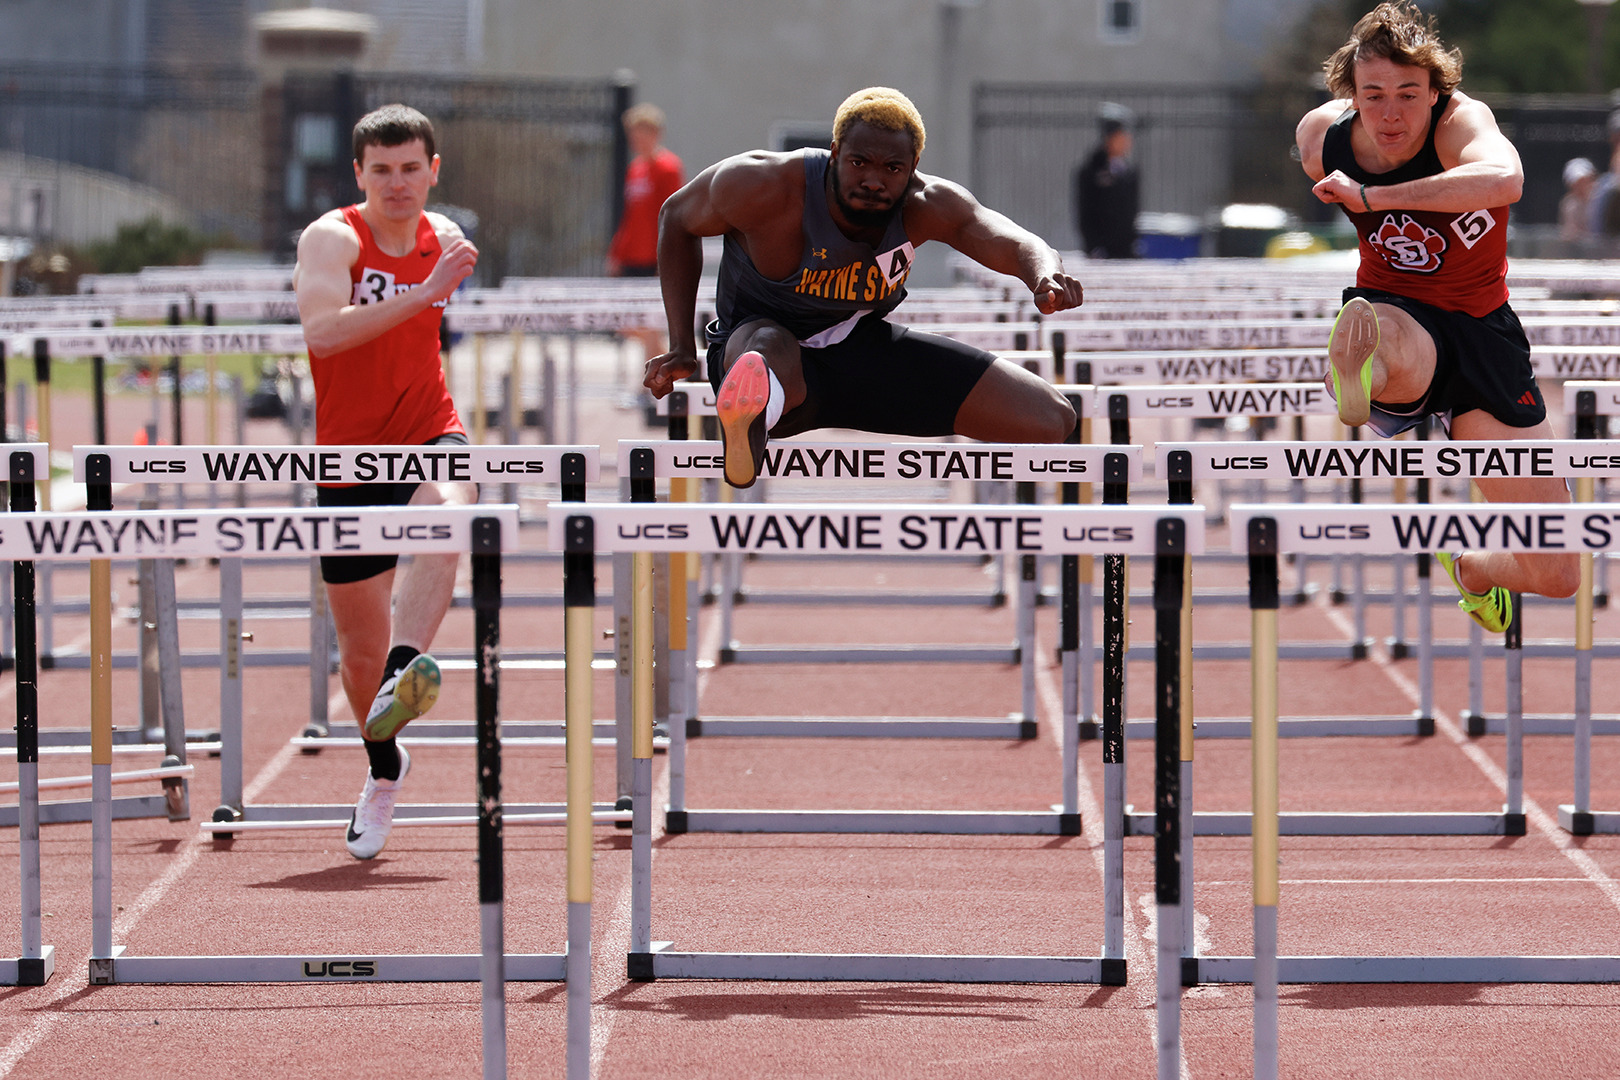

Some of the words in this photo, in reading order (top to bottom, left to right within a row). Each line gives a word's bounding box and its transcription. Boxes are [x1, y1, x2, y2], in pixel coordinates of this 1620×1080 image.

[1457, 211, 1488, 242] 5
[360, 273, 387, 305] 3
[795, 261, 863, 301] WAYNE
[863, 265, 910, 302] ST
[106, 334, 193, 351] WAYNE
[200, 333, 272, 350] STATE
[1156, 357, 1256, 379] WAYNE
[1265, 355, 1331, 379] STAT
[1552, 354, 1620, 375] WAY
[1146, 397, 1194, 408] UCS
[1208, 389, 1322, 413] WAYNE
[129, 460, 187, 473] UCS
[202, 453, 342, 481] WAYNE
[353, 452, 471, 482] STATE
[486, 460, 544, 474] UCS
[757, 449, 886, 478] WAYNE
[897, 450, 1014, 479] STATE
[1029, 460, 1087, 473] UCS
[1210, 456, 1268, 470] UCS
[1284, 448, 1424, 476] WAYNE
[1436, 447, 1554, 477] STATE
[1569, 455, 1620, 469] UCS
[26, 518, 199, 554] WAYNE
[215, 516, 361, 552] STATE
[381, 525, 452, 541] UCS
[618, 523, 689, 540] UCS
[710, 515, 882, 549] WAYNE
[898, 515, 1043, 550] STATE
[1063, 526, 1134, 542] UCS
[1299, 525, 1371, 540] UCS
[1391, 514, 1566, 549] WAYNE
[1582, 513, 1620, 549] S
[304, 961, 375, 977] UCS
